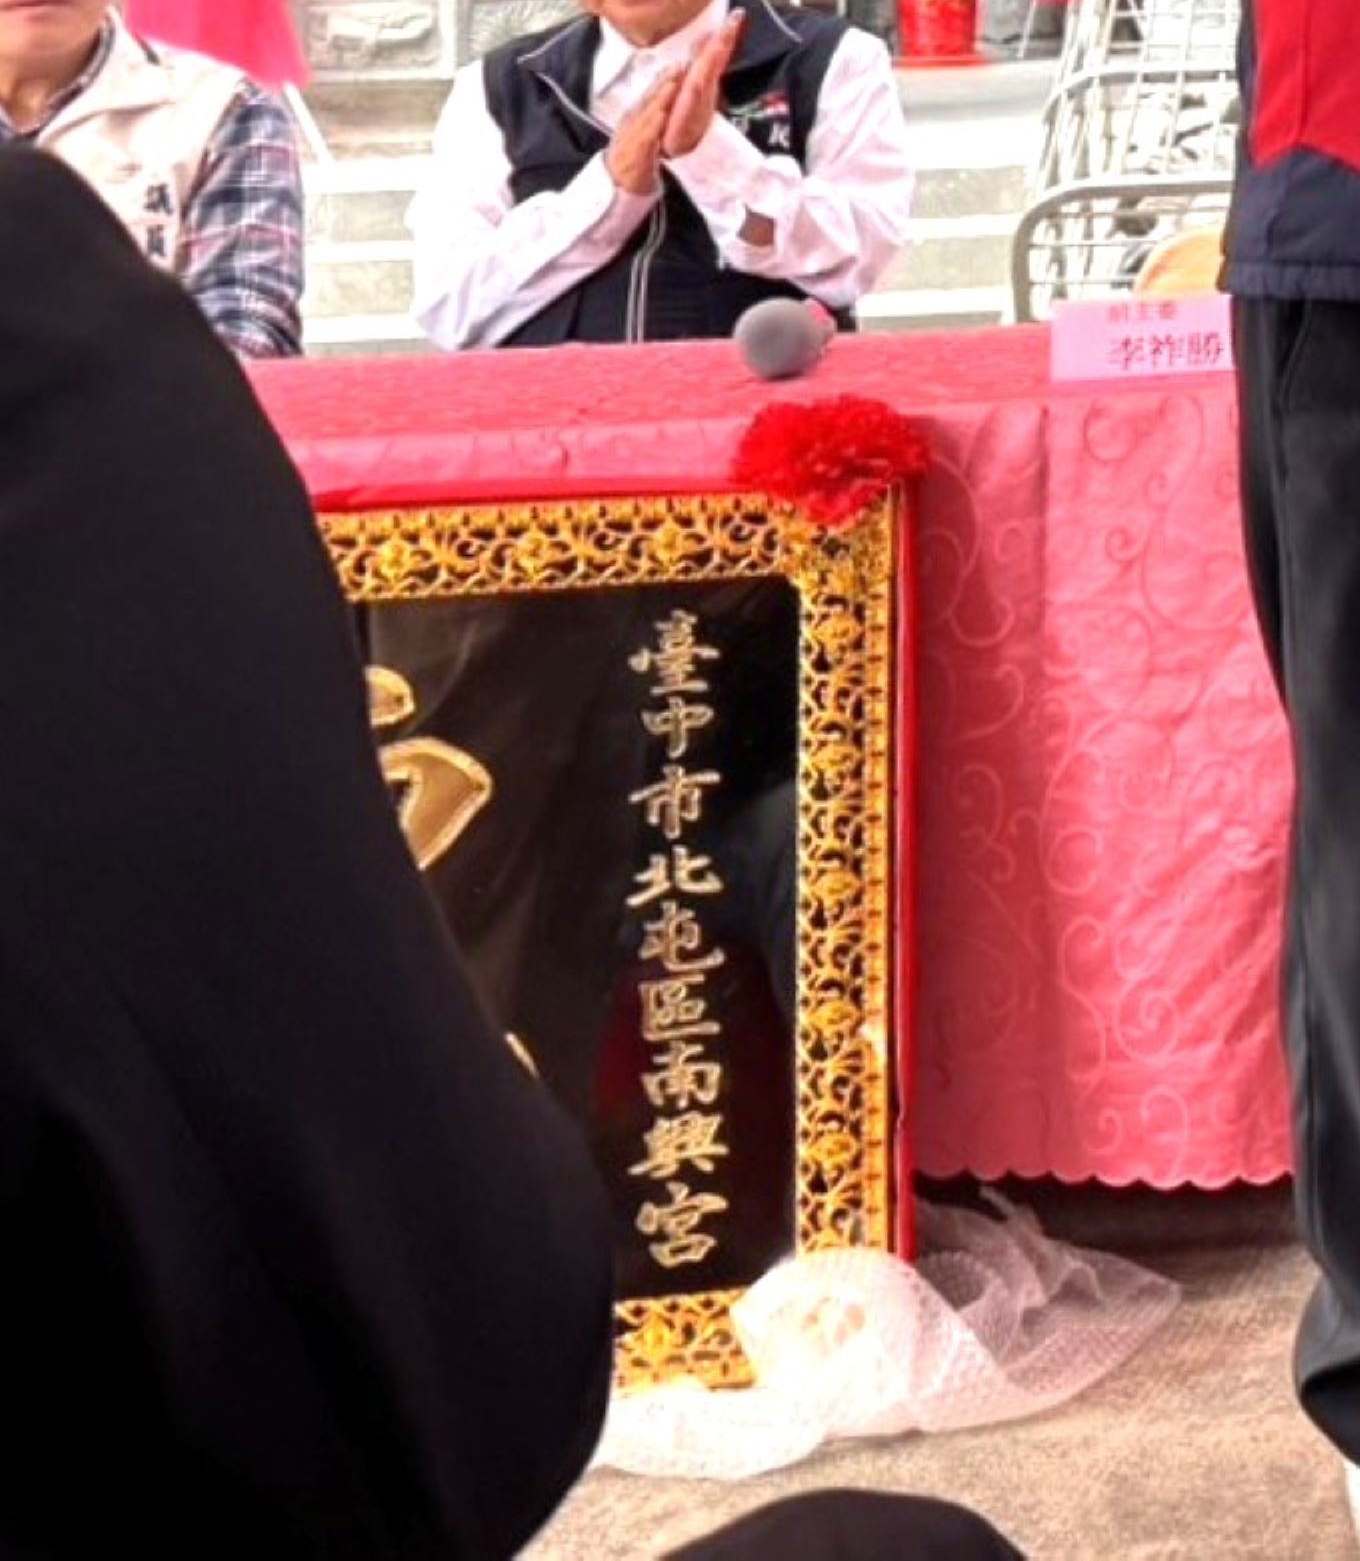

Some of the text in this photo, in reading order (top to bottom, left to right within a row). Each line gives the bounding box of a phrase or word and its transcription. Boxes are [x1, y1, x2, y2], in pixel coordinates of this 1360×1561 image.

[626, 607, 731, 1272] 臺中市北屯區南興宮
